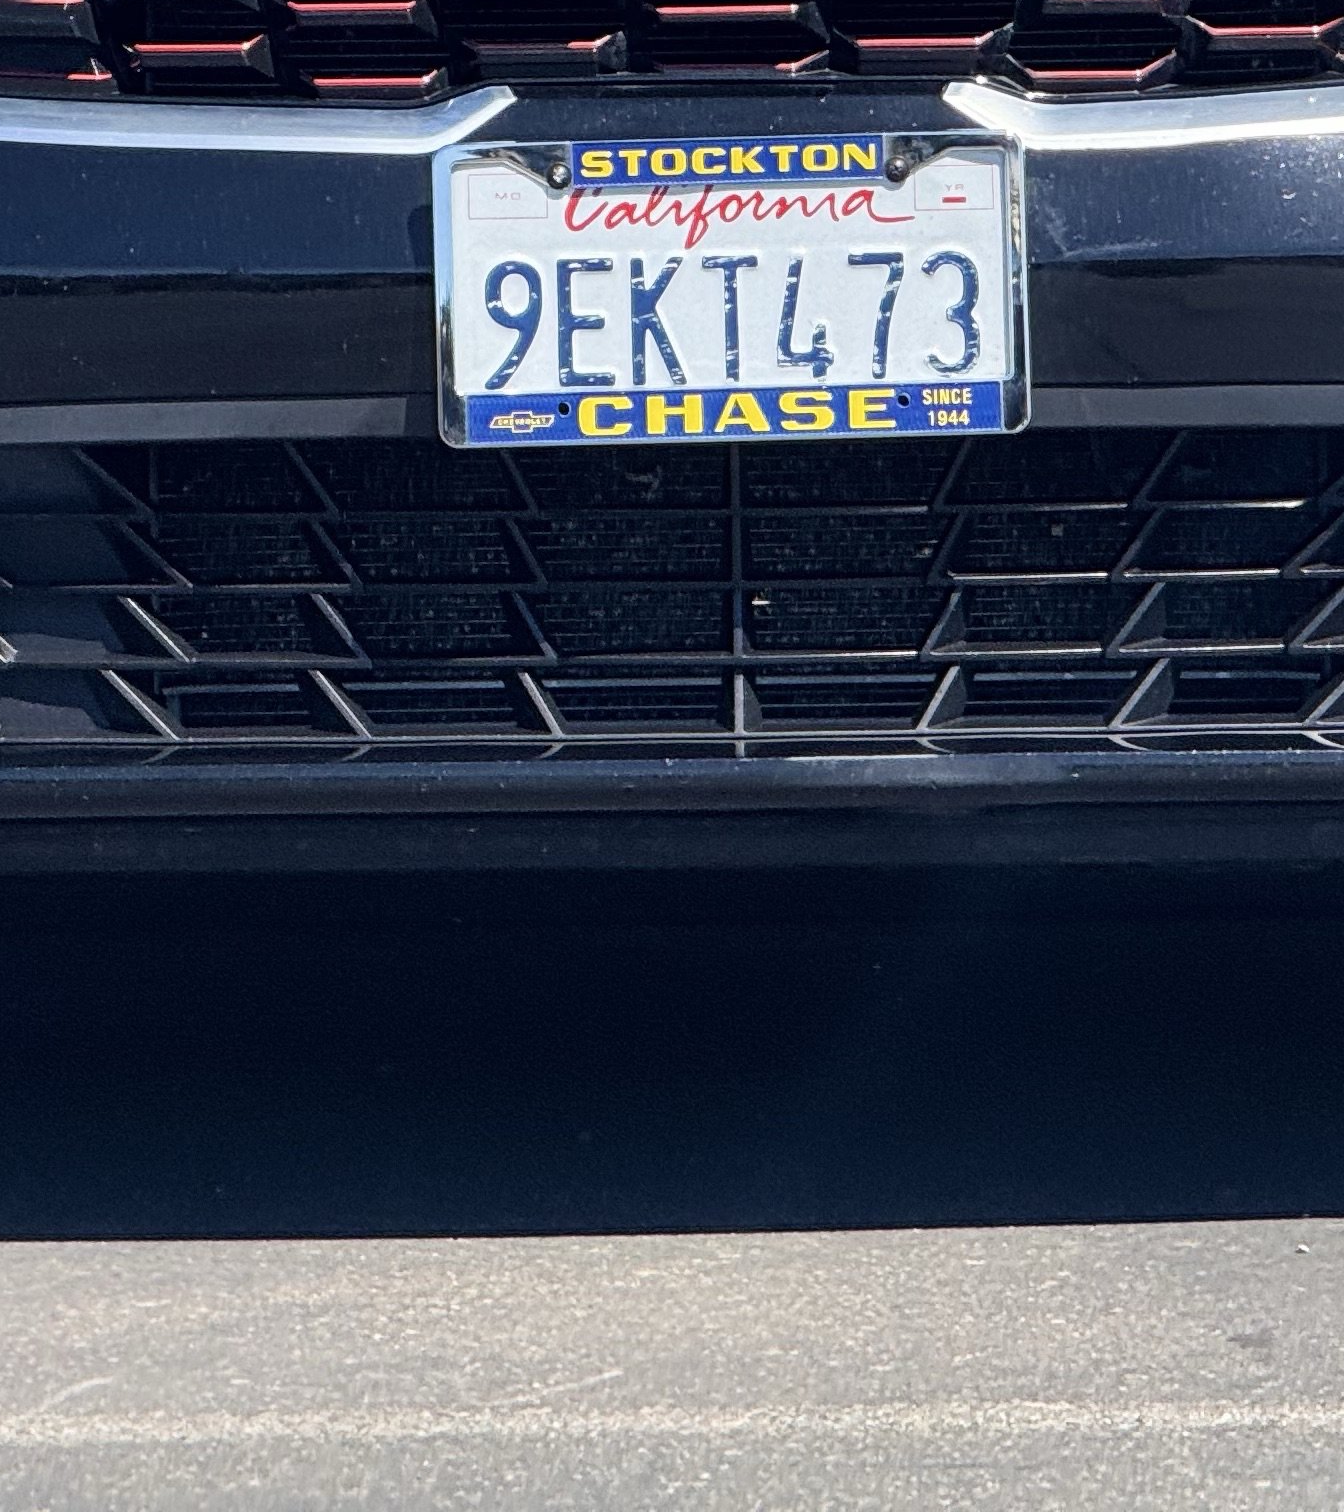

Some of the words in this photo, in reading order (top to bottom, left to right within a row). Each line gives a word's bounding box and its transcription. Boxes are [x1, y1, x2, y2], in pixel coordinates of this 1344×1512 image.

[580, 142, 878, 179] STOCKTON
[564, 184, 916, 250] California
[484, 250, 981, 390] 9EKT473
[578, 388, 896, 437] CHASE
[921, 387, 973, 406] SINCE
[927, 409, 971, 427] 1944
